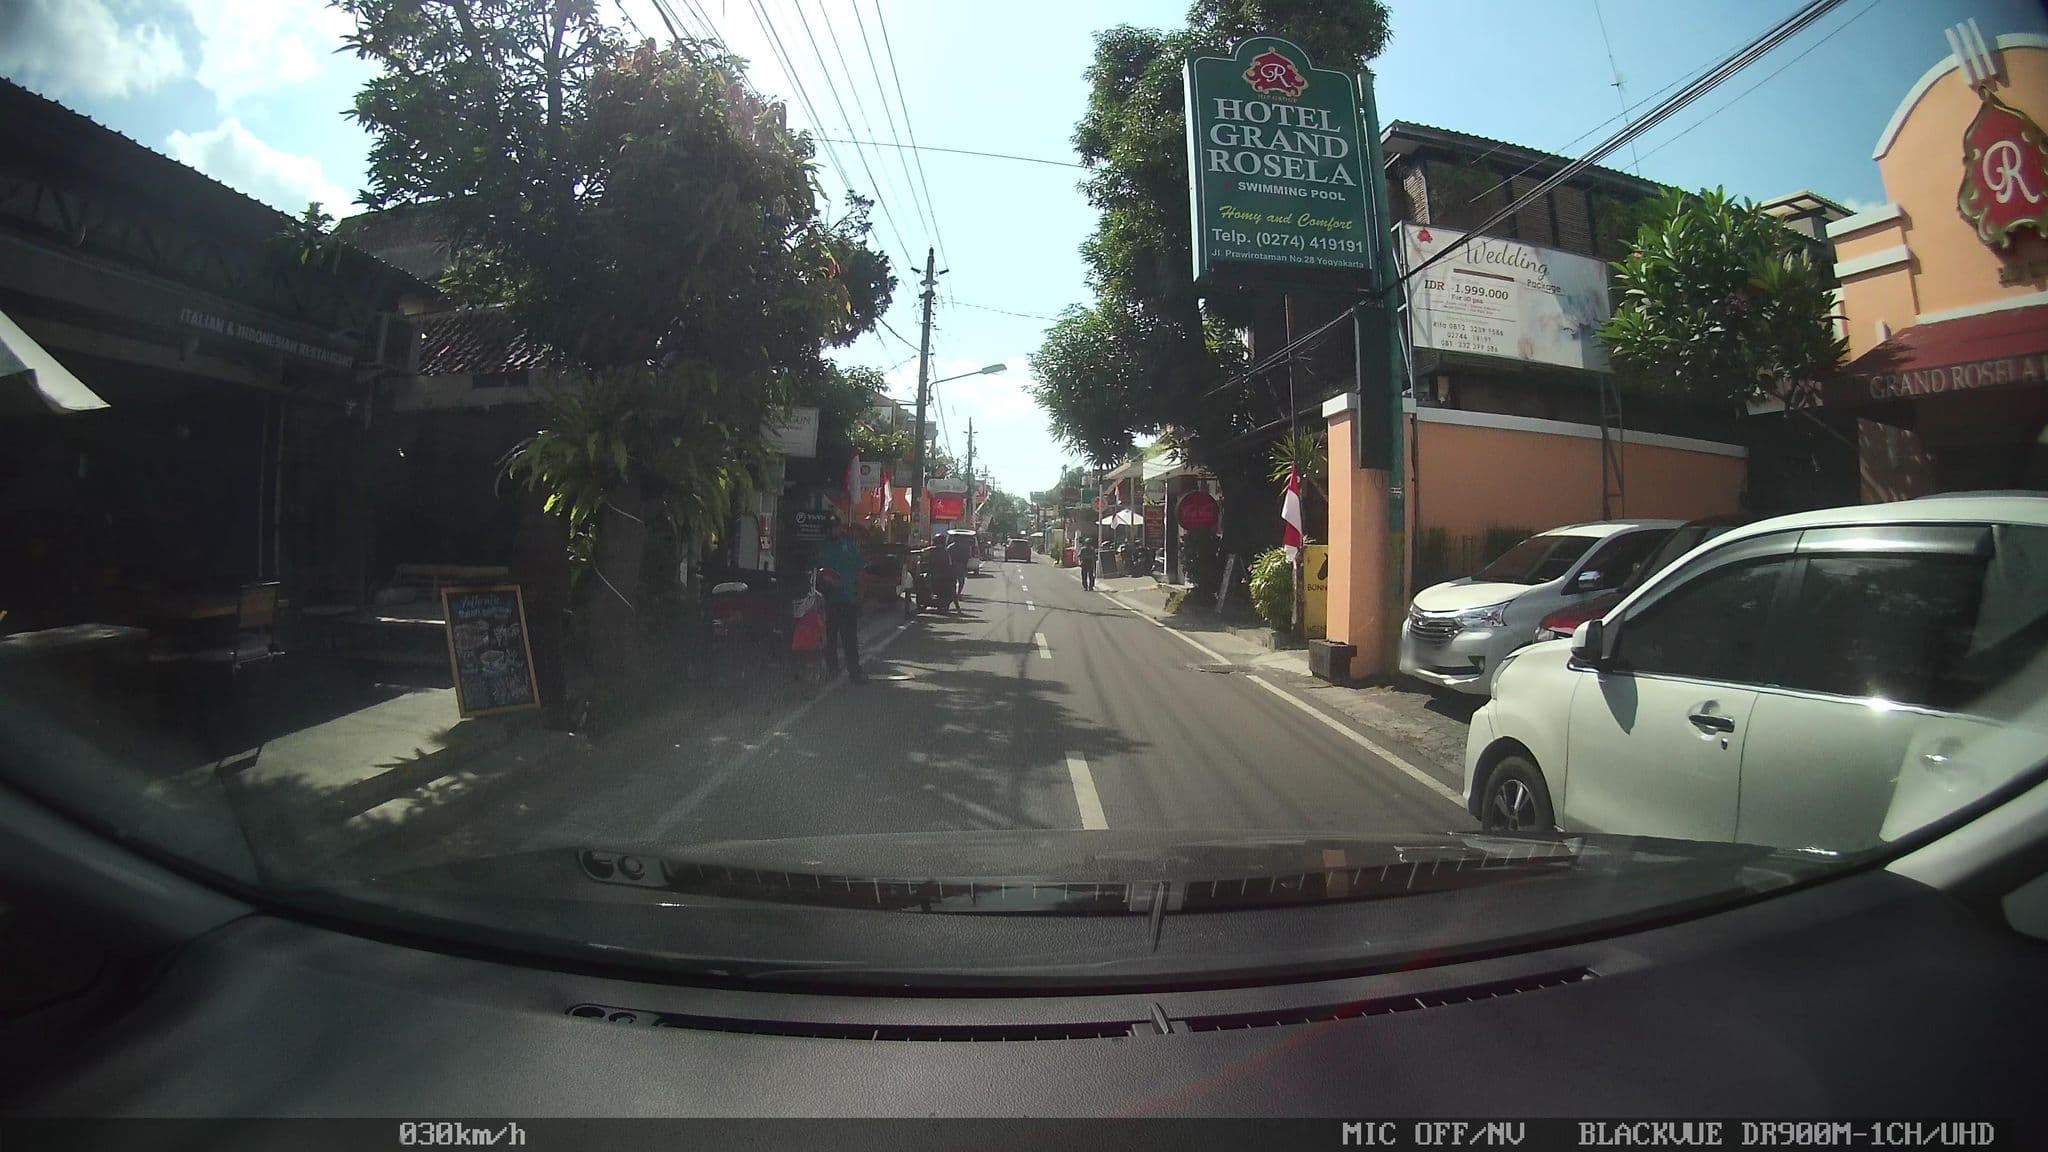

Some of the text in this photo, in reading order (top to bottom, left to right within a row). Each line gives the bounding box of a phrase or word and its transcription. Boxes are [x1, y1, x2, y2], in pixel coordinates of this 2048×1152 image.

[1213, 98, 1341, 133] HOTEL
[1210, 123, 1349, 159] GRAND
[1206, 149, 1357, 187] ROSELA
[1238, 181, 1346, 201] SWIMMING POOL
[1218, 205, 1353, 231] Homy and Comfort
[1211, 228, 1363, 254] Telp. (0274) 419191
[1225, 250, 1287, 262] Prawirotaman
[1317, 257, 1364, 269] Yogyakarta
[1461, 240, 1550, 282] Wedding
[1424, 279, 1445, 291] IDR
[1454, 283, 1509, 300] 1.999.000
[180, 308, 353, 369] ITALIAN & INDONESIAN RESTAURANT
[1869, 368, 1946, 400] GRAND
